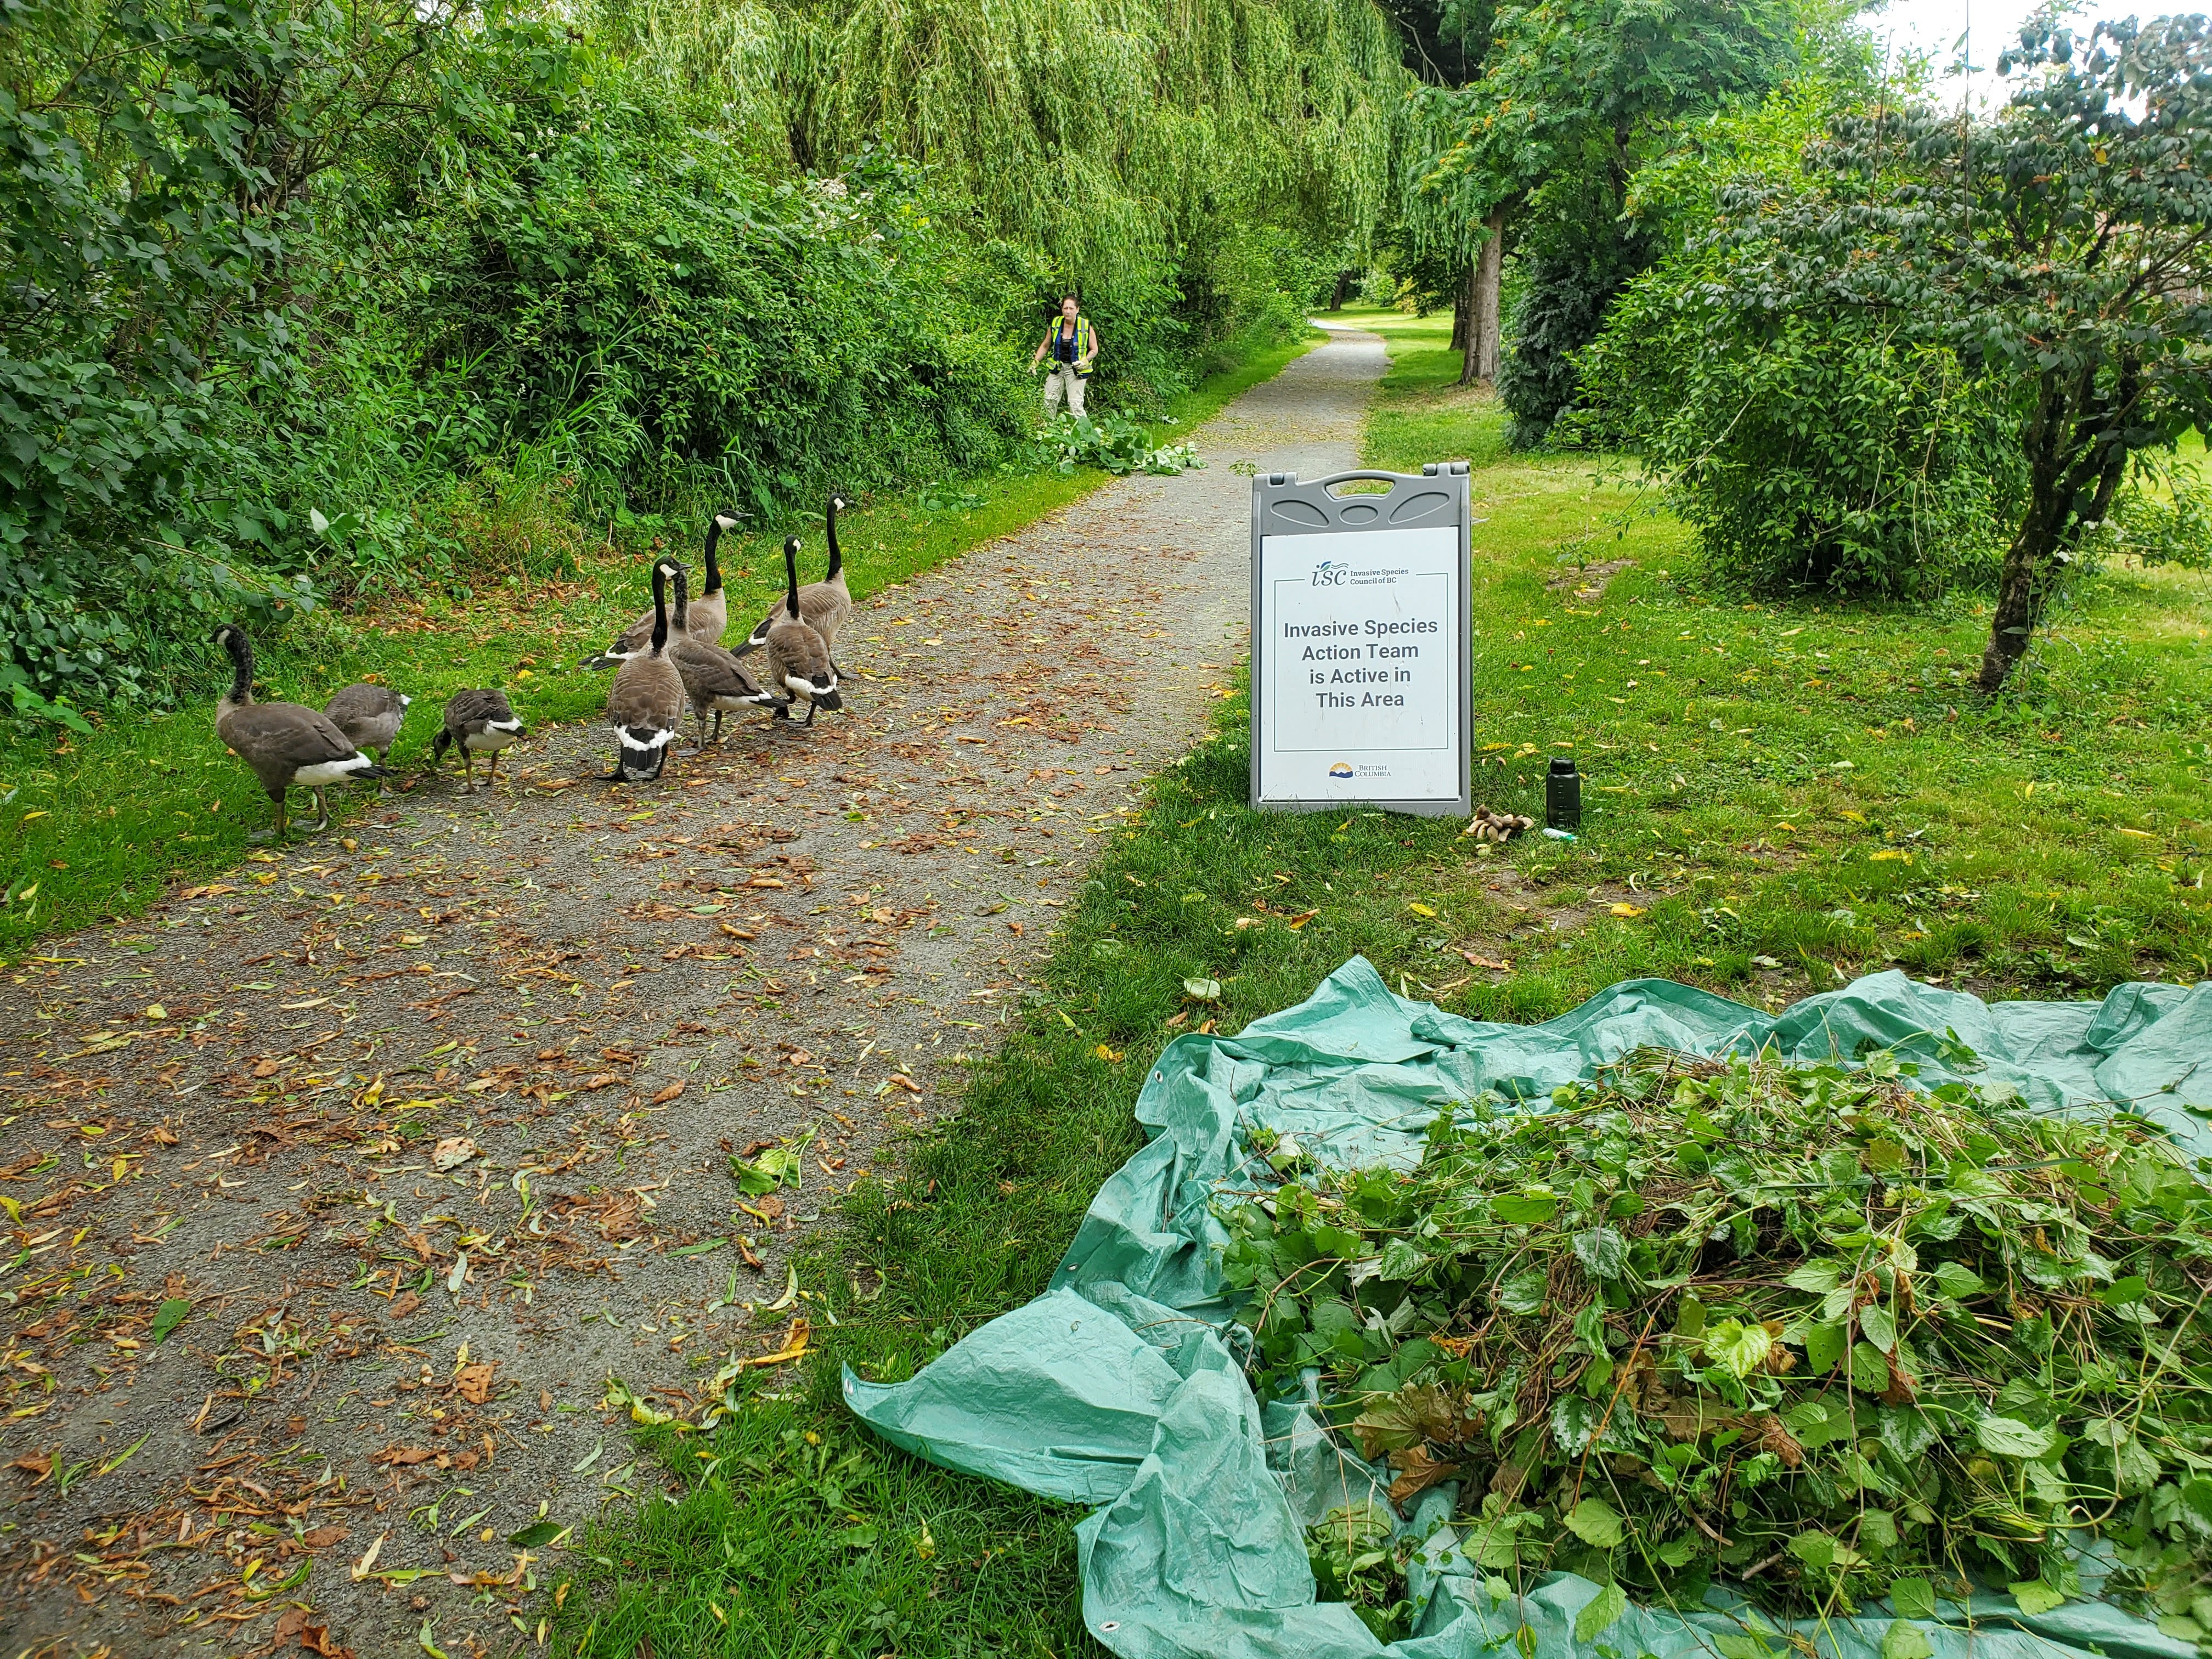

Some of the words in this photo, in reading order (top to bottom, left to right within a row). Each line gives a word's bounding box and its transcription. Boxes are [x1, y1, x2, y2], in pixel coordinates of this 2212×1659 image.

[1381, 568, 1409, 576] Species
[1284, 620, 1358, 637] Invasive
[1364, 618, 1438, 639] Species
[1301, 645, 1361, 661] Action
[1365, 644, 1418, 659] Team
[1310, 669, 1325, 684] is
[1330, 668, 1389, 684] Active
[1395, 667, 1410, 682] in
[1316, 692, 1355, 708] This
[1361, 692, 1404, 707] Area
